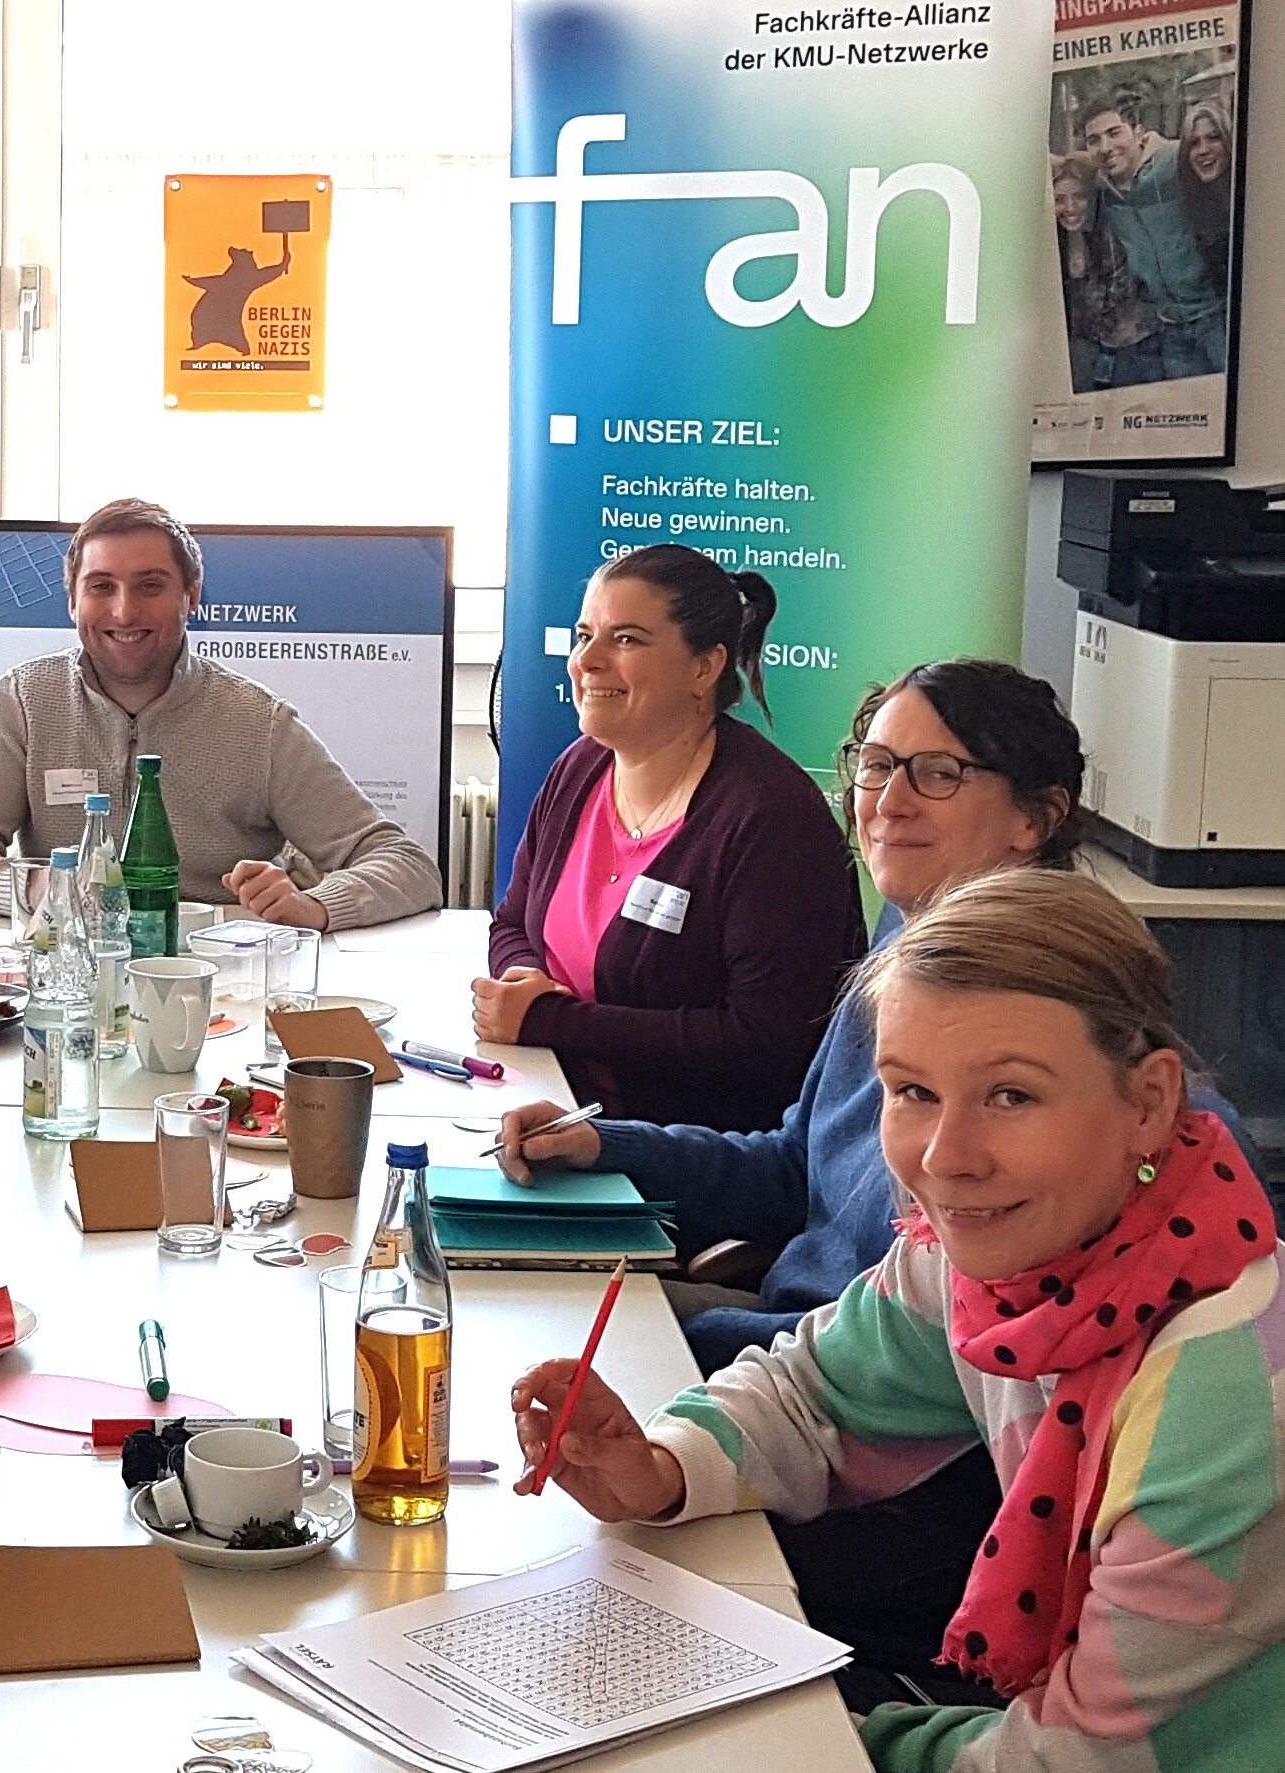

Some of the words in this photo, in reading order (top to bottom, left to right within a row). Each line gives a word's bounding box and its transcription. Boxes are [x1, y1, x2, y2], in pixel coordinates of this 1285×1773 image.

[755, 3, 991, 35] Fachkräfte-Allianz
[1053, 35, 1112, 61] EINER
[1120, 17, 1226, 51] KARRIERE
[724, 50, 767, 71] der
[774, 38, 990, 69] KMU-Netzwerke
[510, 114, 982, 328] fan
[248, 306, 312, 321] BERLIN
[258, 324, 312, 339] GEGEN
[257, 341, 311, 356] NAZIS
[603, 418, 703, 445] UNSER
[711, 420, 781, 447] ZIEL:
[1123, 415, 1143, 429] NG
[601, 475, 728, 499] Fachkräfte
[734, 477, 816, 502] halten.
[601, 507, 663, 529] Neue
[669, 511, 791, 535] gewinnen.
[745, 545, 847, 570] handeln.
[763, 643, 838, 669] SION:
